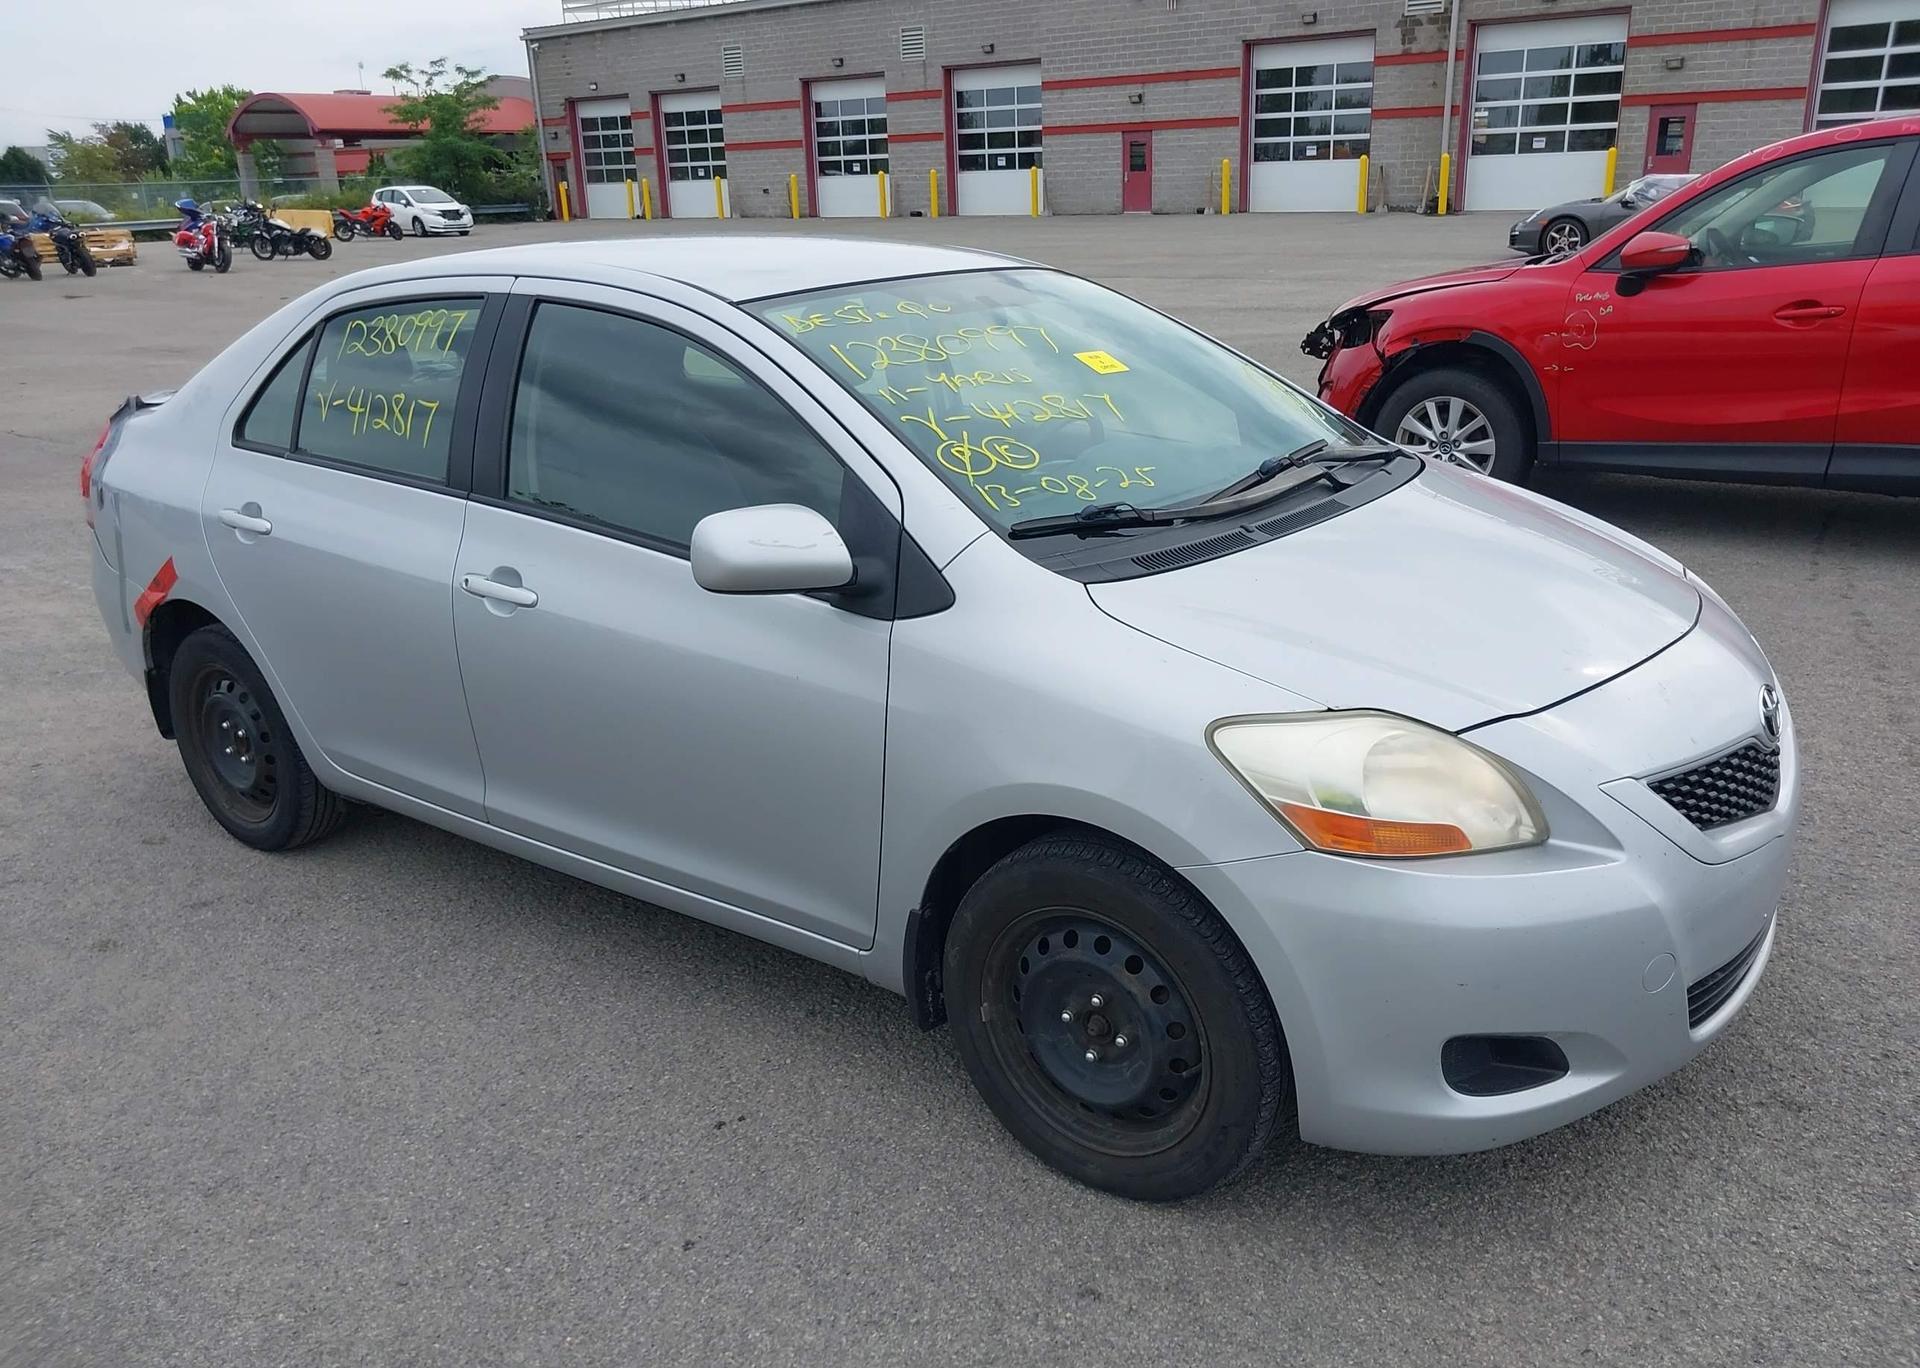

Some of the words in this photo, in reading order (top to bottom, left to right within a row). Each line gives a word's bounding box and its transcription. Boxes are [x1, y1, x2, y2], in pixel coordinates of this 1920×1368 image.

[337, 308, 467, 361] 12380997
[829, 324, 1060, 380] 12380997
[317, 379, 441, 449] V-412817
[973, 465, 1158, 513] 13-08-25
